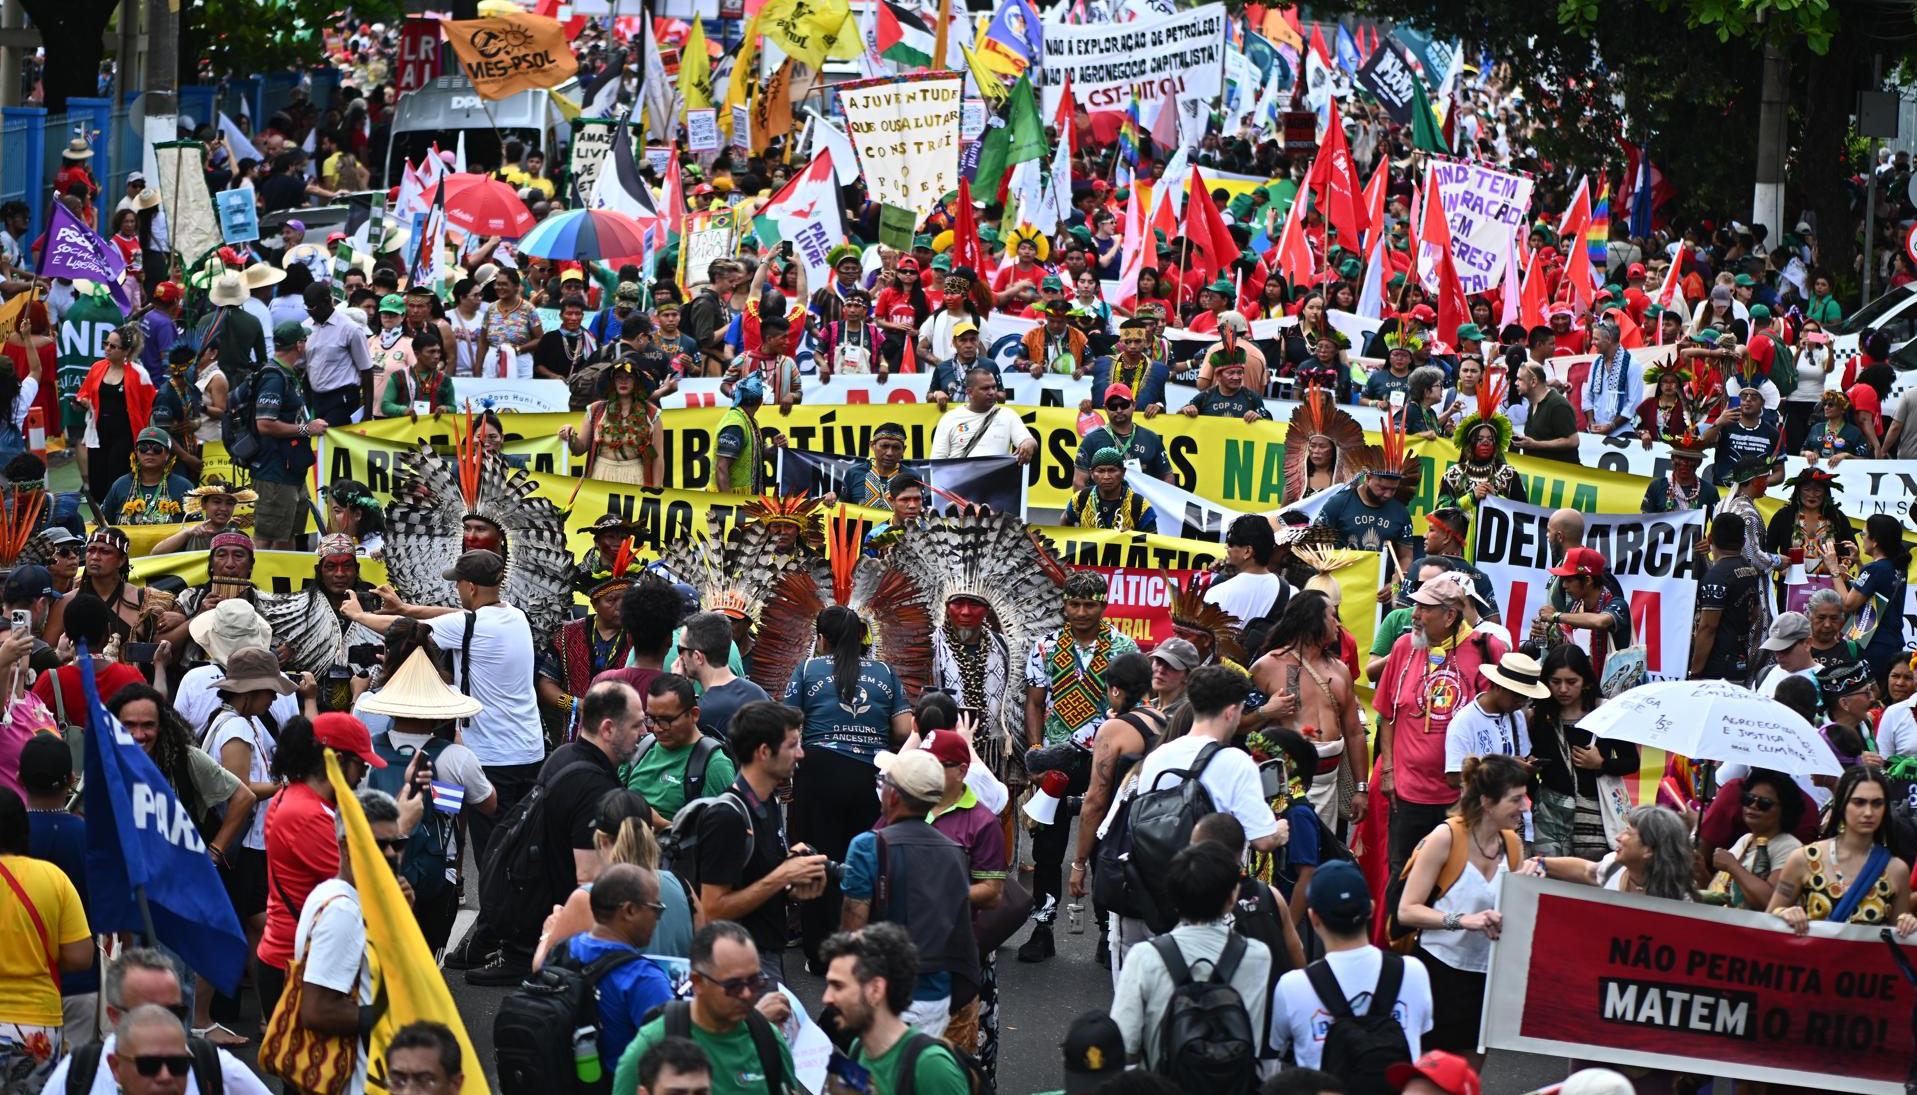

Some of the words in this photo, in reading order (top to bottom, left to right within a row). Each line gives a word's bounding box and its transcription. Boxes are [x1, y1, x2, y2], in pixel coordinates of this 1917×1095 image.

[849, 97, 858, 109] A
[862, 88, 958, 109] JUVENTUDE
[851, 122, 876, 133] QUE
[1476, 169, 1519, 200] TEM
[794, 228, 825, 269] LIVRE
[1213, 402, 1230, 411] COP
[1233, 402, 1244, 411] 30
[1354, 514, 1375, 527] COP
[1377, 517, 1391, 530] 30
[808, 680, 824, 698] COP
[833, 724, 840, 732] O
[842, 724, 877, 734] FUTURO
[1608, 935, 1676, 973] NÃO
[1687, 949, 1823, 996] PERMITA
[1836, 970, 1899, 1002] QUE
[1762, 1007, 1791, 1043] O
[1805, 1009, 1889, 1053] RIO!
